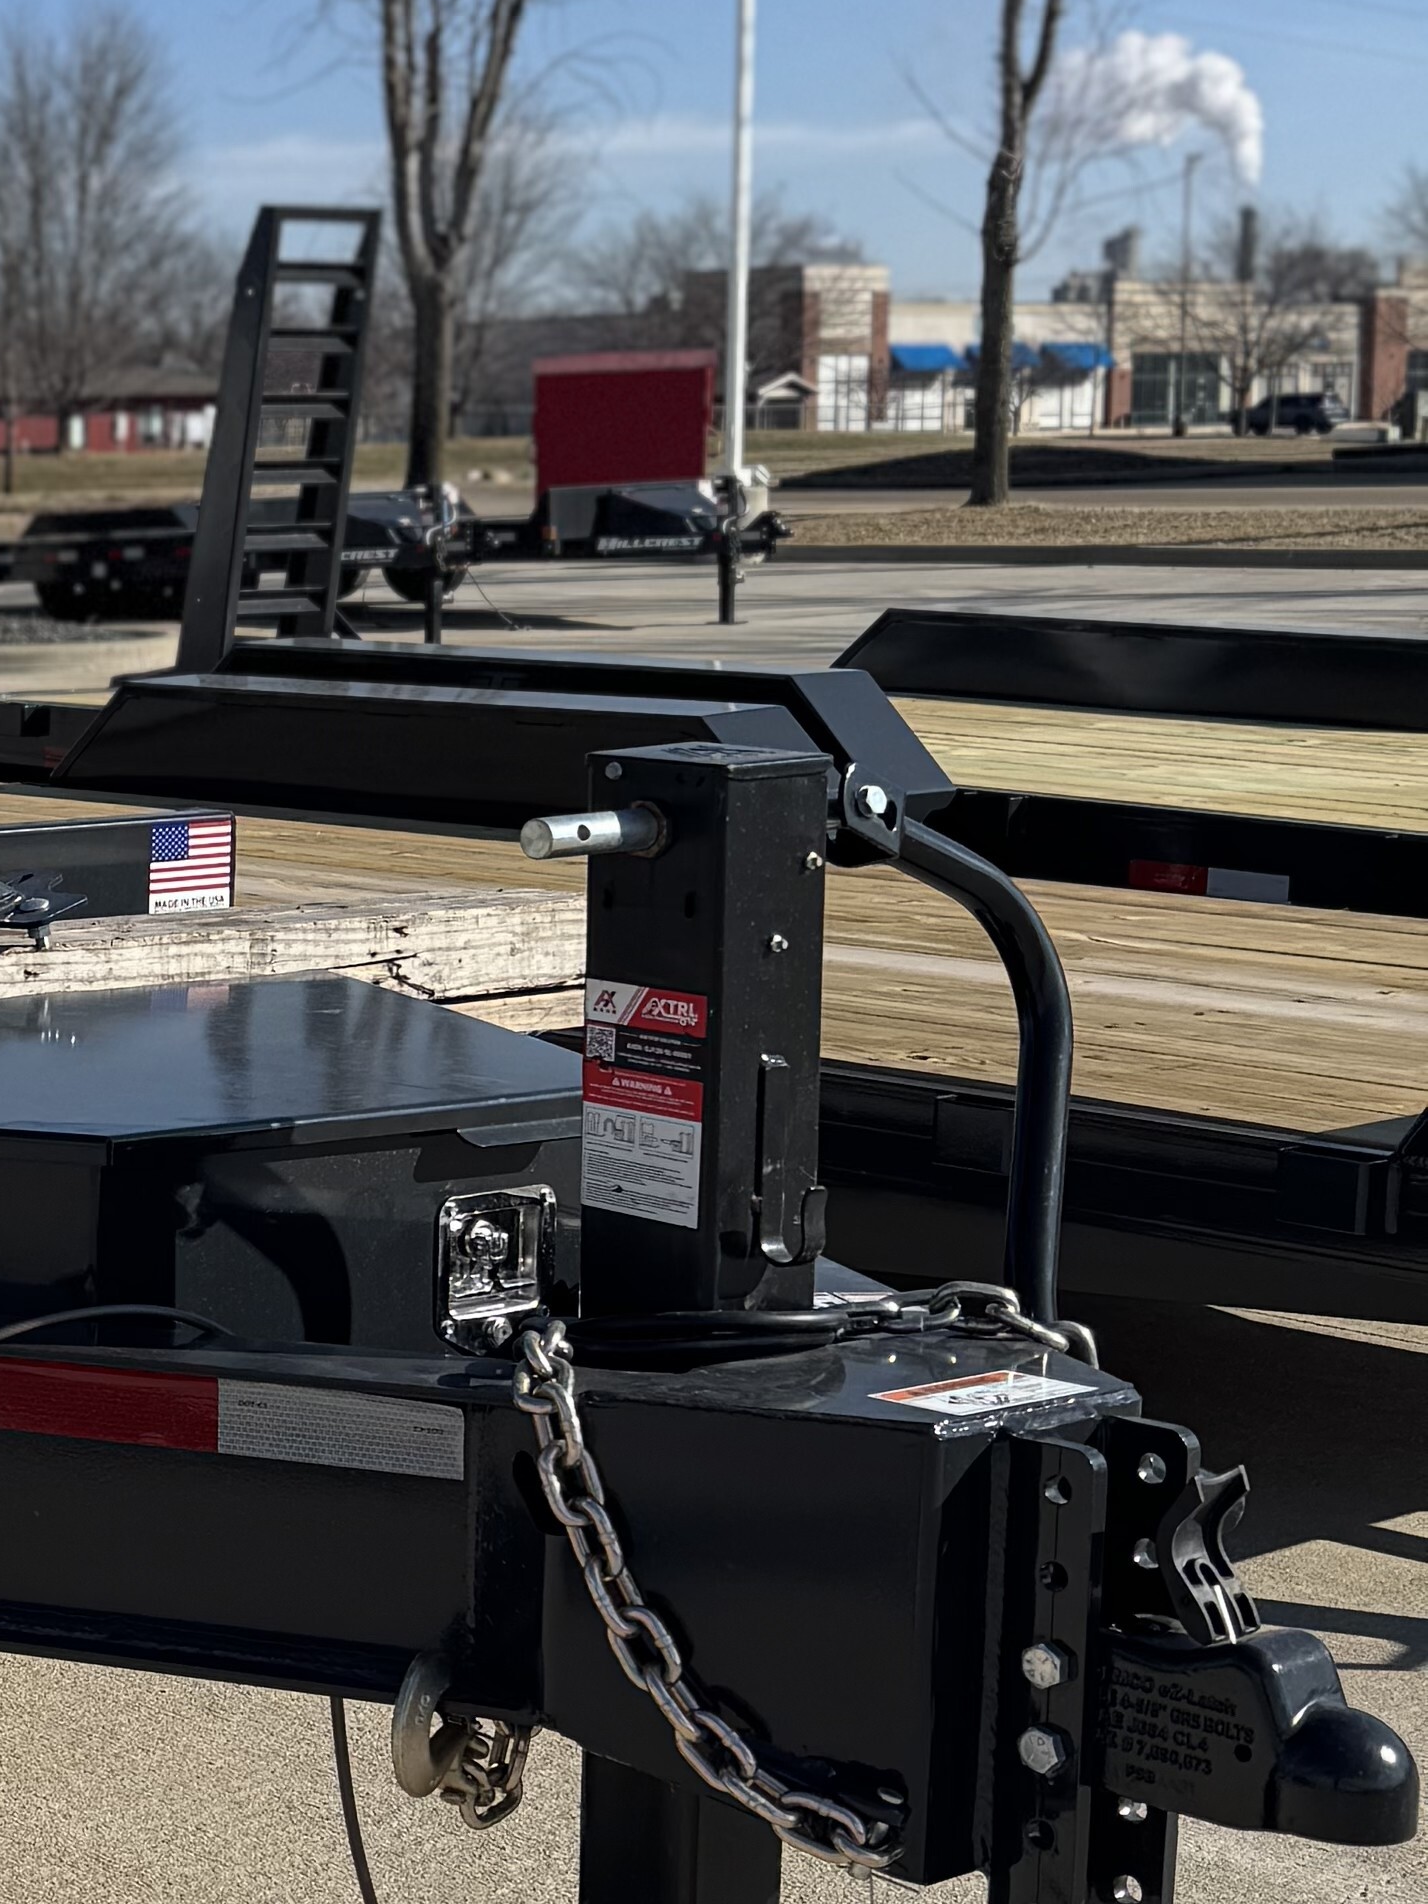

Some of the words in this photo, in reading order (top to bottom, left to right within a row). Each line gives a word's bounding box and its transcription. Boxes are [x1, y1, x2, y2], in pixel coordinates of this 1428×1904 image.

[341, 549, 399, 561] CREST
[154, 898, 178, 908] MADE
[180, 898, 189, 907] IN
[192, 896, 206, 906] THE
[208, 895, 225, 905] USA
[620, 1078, 663, 1093] WARNING
